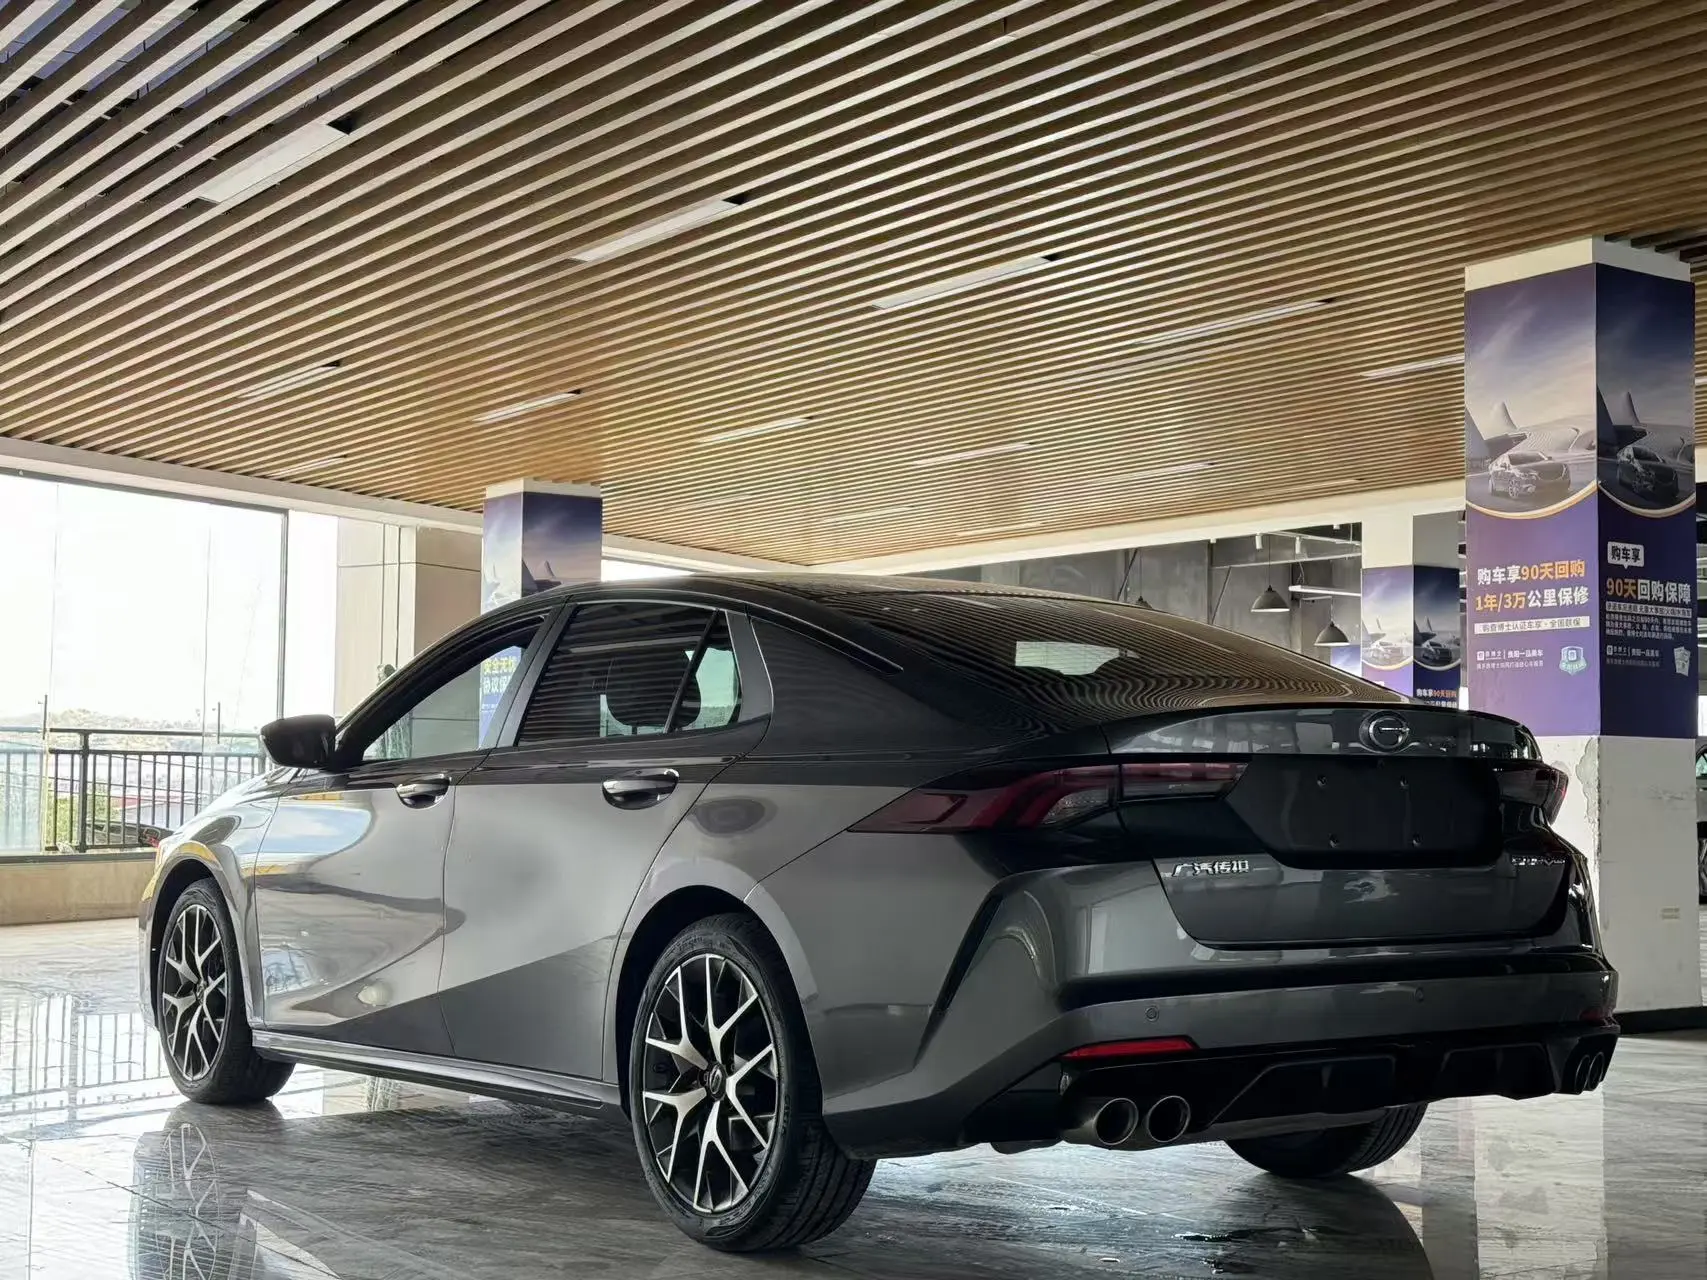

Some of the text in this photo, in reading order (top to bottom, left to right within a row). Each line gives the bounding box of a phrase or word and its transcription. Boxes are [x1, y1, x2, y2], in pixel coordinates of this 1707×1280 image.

[1611, 545, 1641, 563] 购车享
[1477, 559, 1586, 586] 购车享90天回购
[1475, 586, 1589, 612] 1年/3万公里保修
[1606, 578, 1692, 604] 90天回购保障
